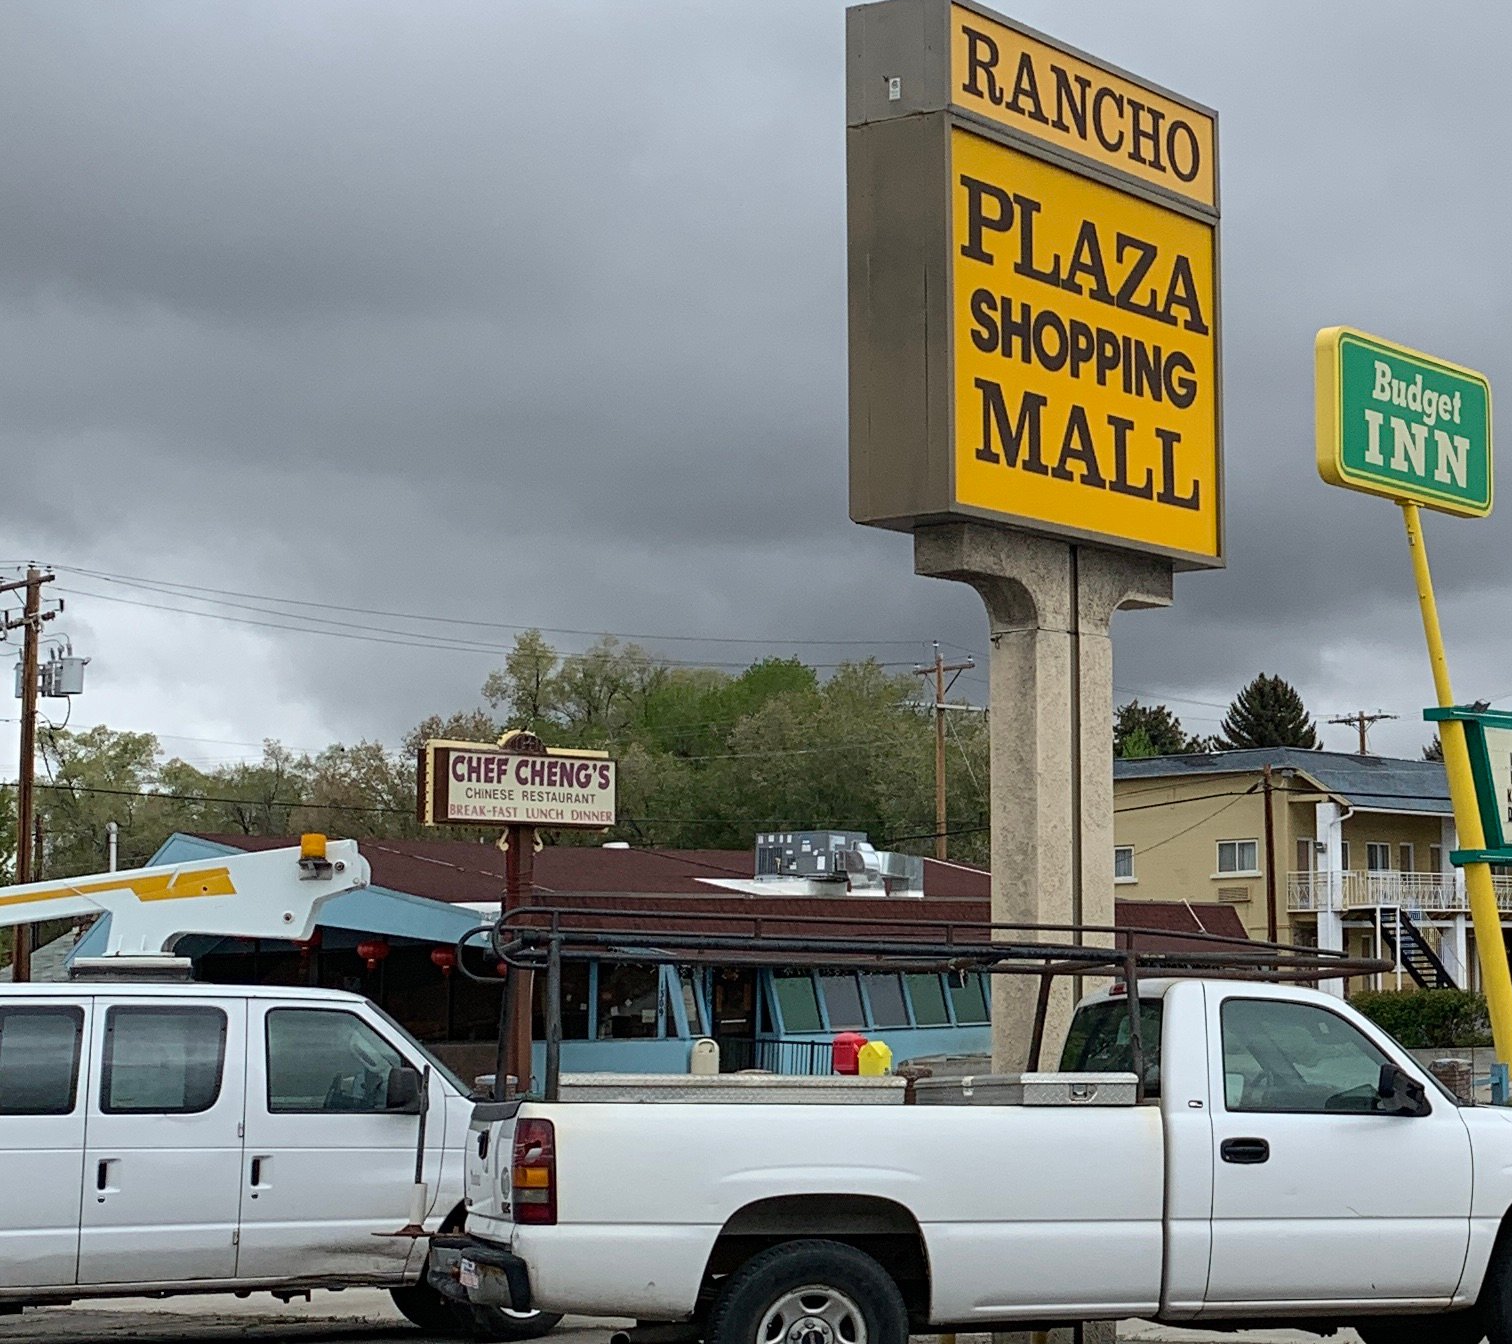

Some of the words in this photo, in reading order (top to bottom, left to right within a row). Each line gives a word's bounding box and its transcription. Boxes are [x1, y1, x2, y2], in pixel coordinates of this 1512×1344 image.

[961, 24, 1200, 182] RANCHO
[960, 174, 1208, 335] PLAZA
[970, 288, 1198, 409] SHOPPING
[1373, 360, 1461, 426] Budget
[975, 377, 1199, 511] MALL
[1364, 409, 1470, 488] INN
[451, 755, 509, 784] CHEF
[515, 759, 610, 790] CHENG'S
[465, 787, 514, 801] CHINESE
[522, 790, 596, 804] RESTAURANT
[450, 804, 517, 818] BREAK-FAST
[526, 807, 564, 821] LUNCH
[571, 809, 613, 822] DINNER
